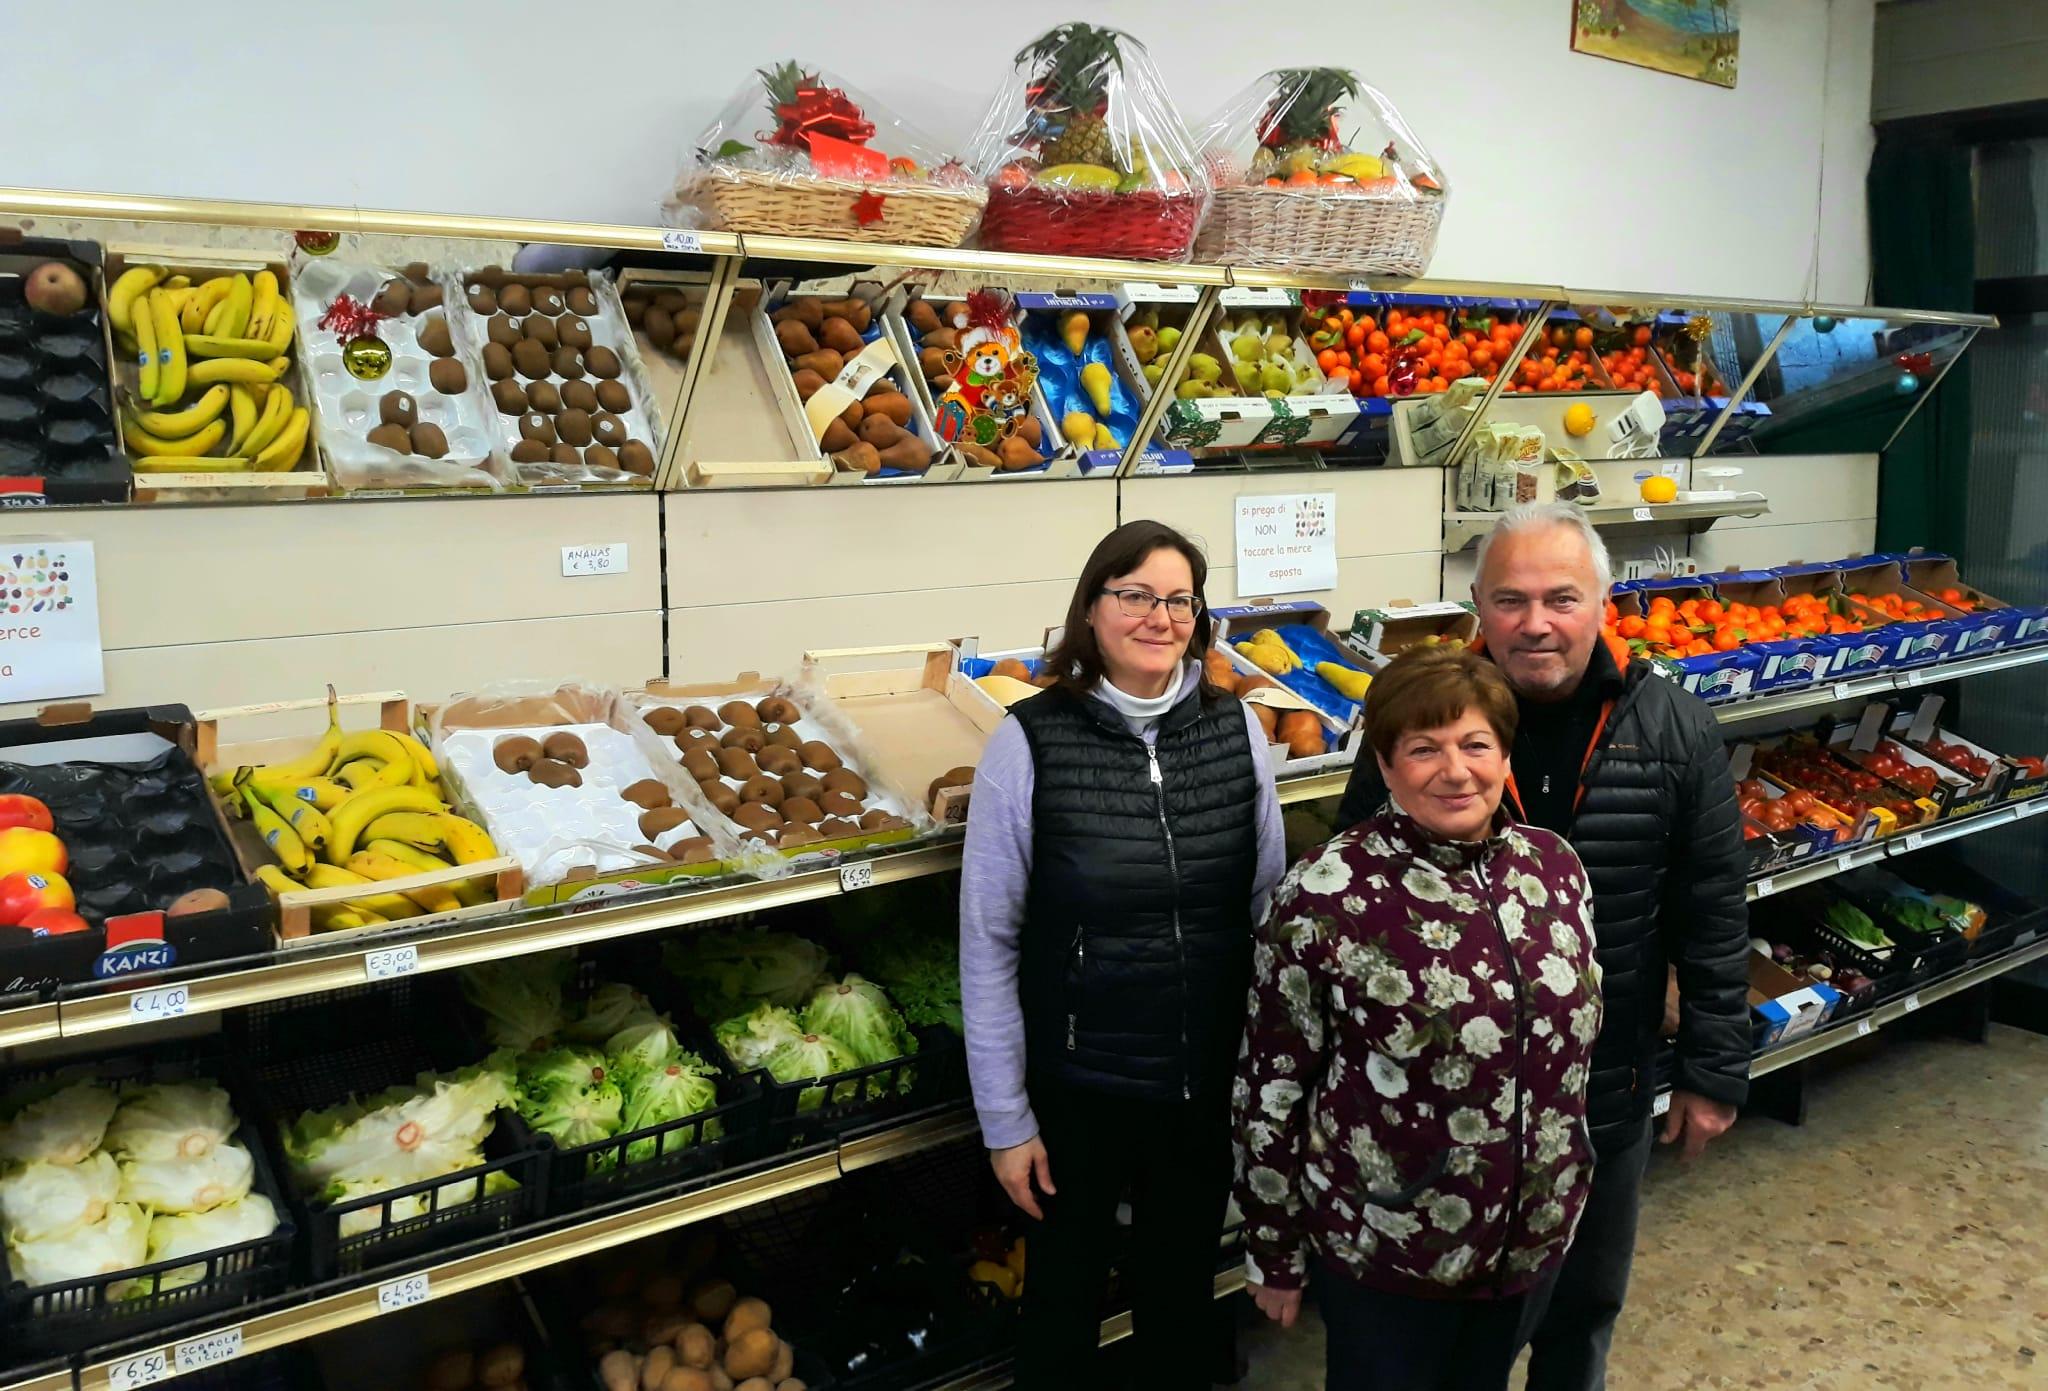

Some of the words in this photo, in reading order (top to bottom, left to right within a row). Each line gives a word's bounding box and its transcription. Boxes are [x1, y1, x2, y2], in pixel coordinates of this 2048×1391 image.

[1242, 507, 1249, 516] si
[1251, 505, 1275, 518] prega
[1278, 503, 1286, 514] di
[1255, 524, 1277, 536] NON
[567, 547, 611, 561] ANANAS
[1243, 547, 1275, 557] toccare
[1277, 544, 1285, 555] la
[1286, 545, 1312, 554] merce
[587, 559, 610, 572] 3,80
[1268, 567, 1302, 580] esposta
